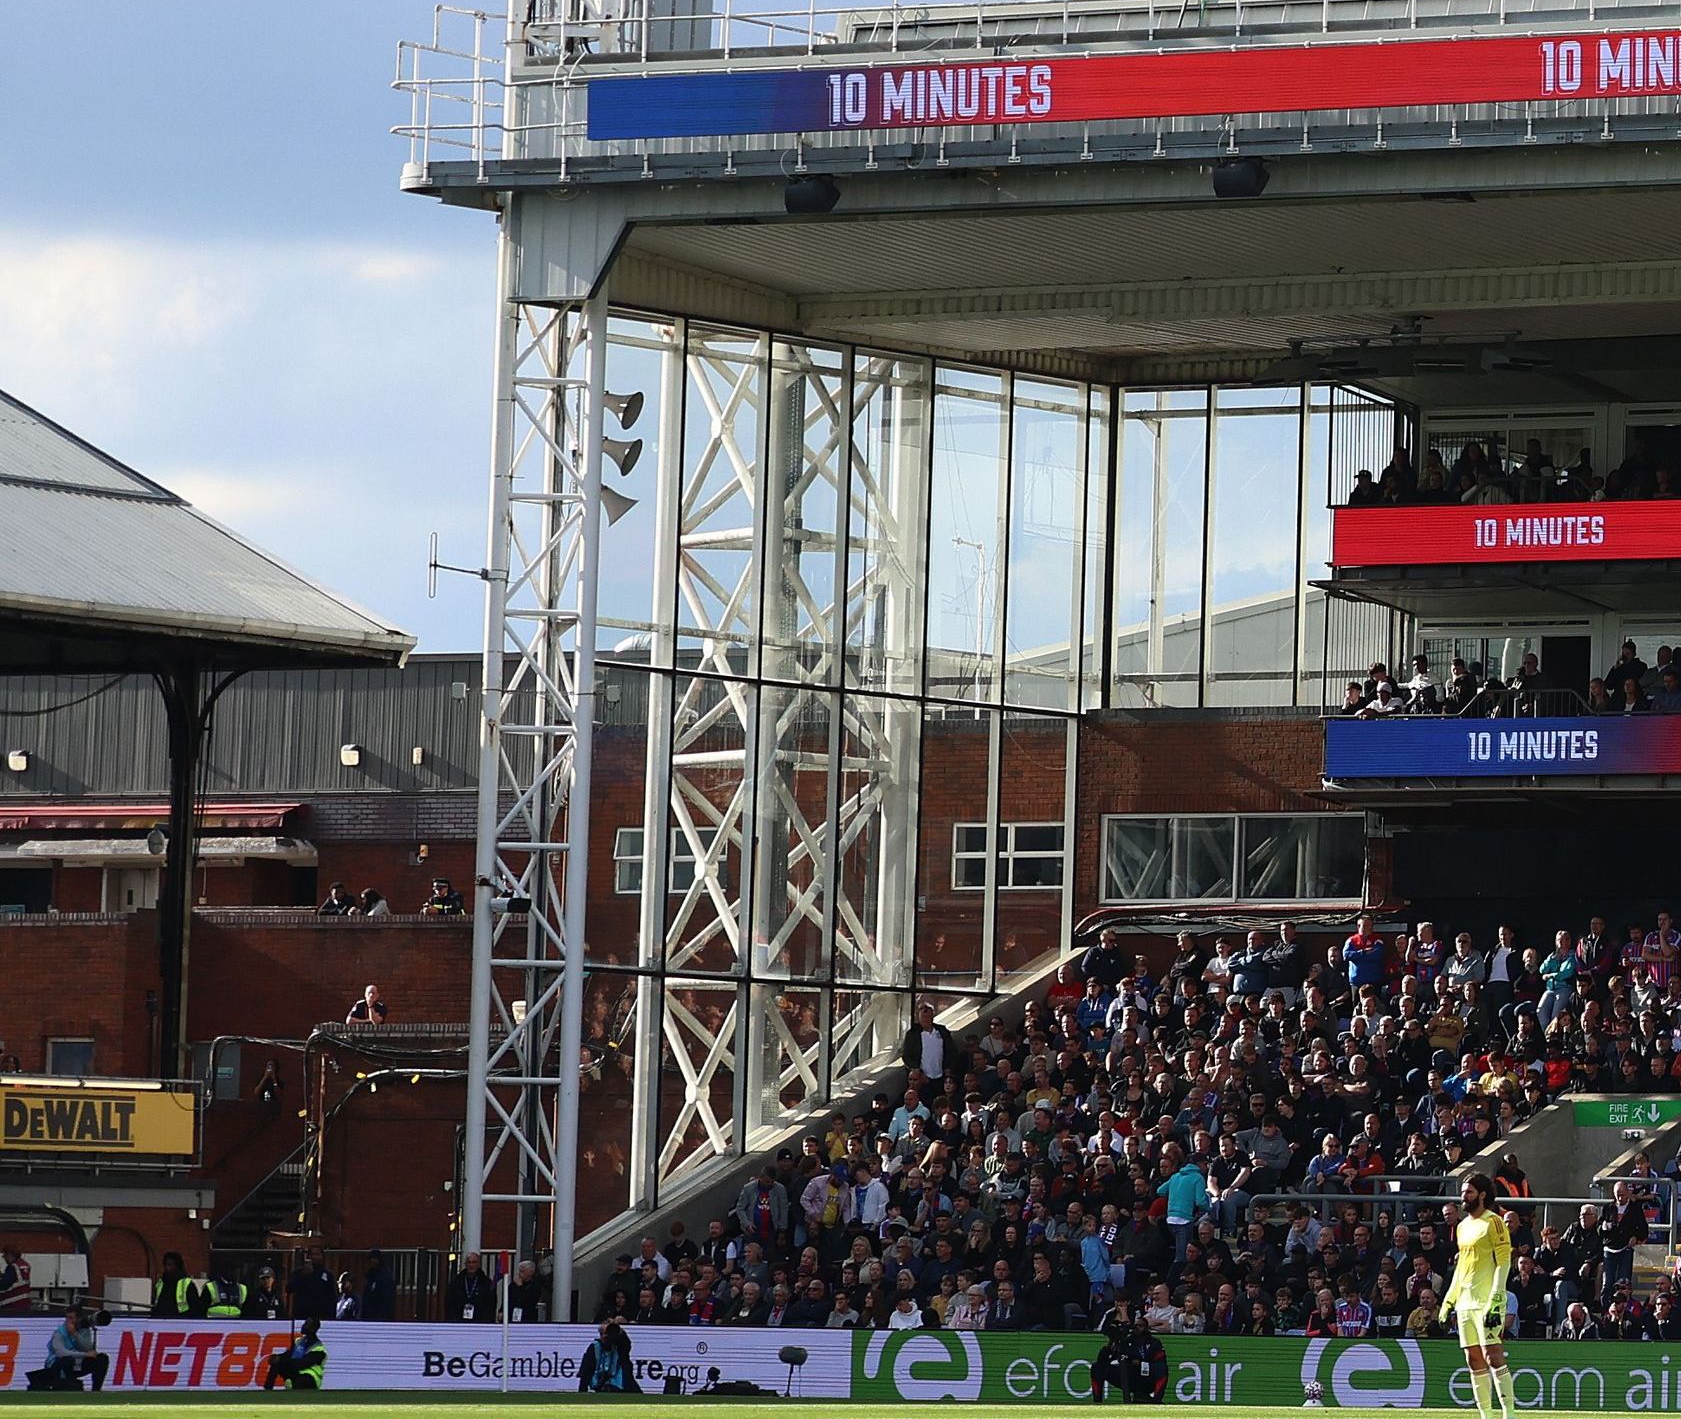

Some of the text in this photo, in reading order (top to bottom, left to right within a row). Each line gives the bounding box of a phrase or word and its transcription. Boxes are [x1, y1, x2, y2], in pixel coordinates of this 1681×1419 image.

[1539, 41, 1581, 95] 10
[826, 65, 1052, 126] 10 MINUTES
[1474, 515, 1604, 548] 10 MINUTES
[1468, 730, 1598, 762] 10 MINUTES
[1609, 1103, 1629, 1113] FIRE
[1609, 1114, 1628, 1124] EXIT
[1175, 1347, 1243, 1402] air
